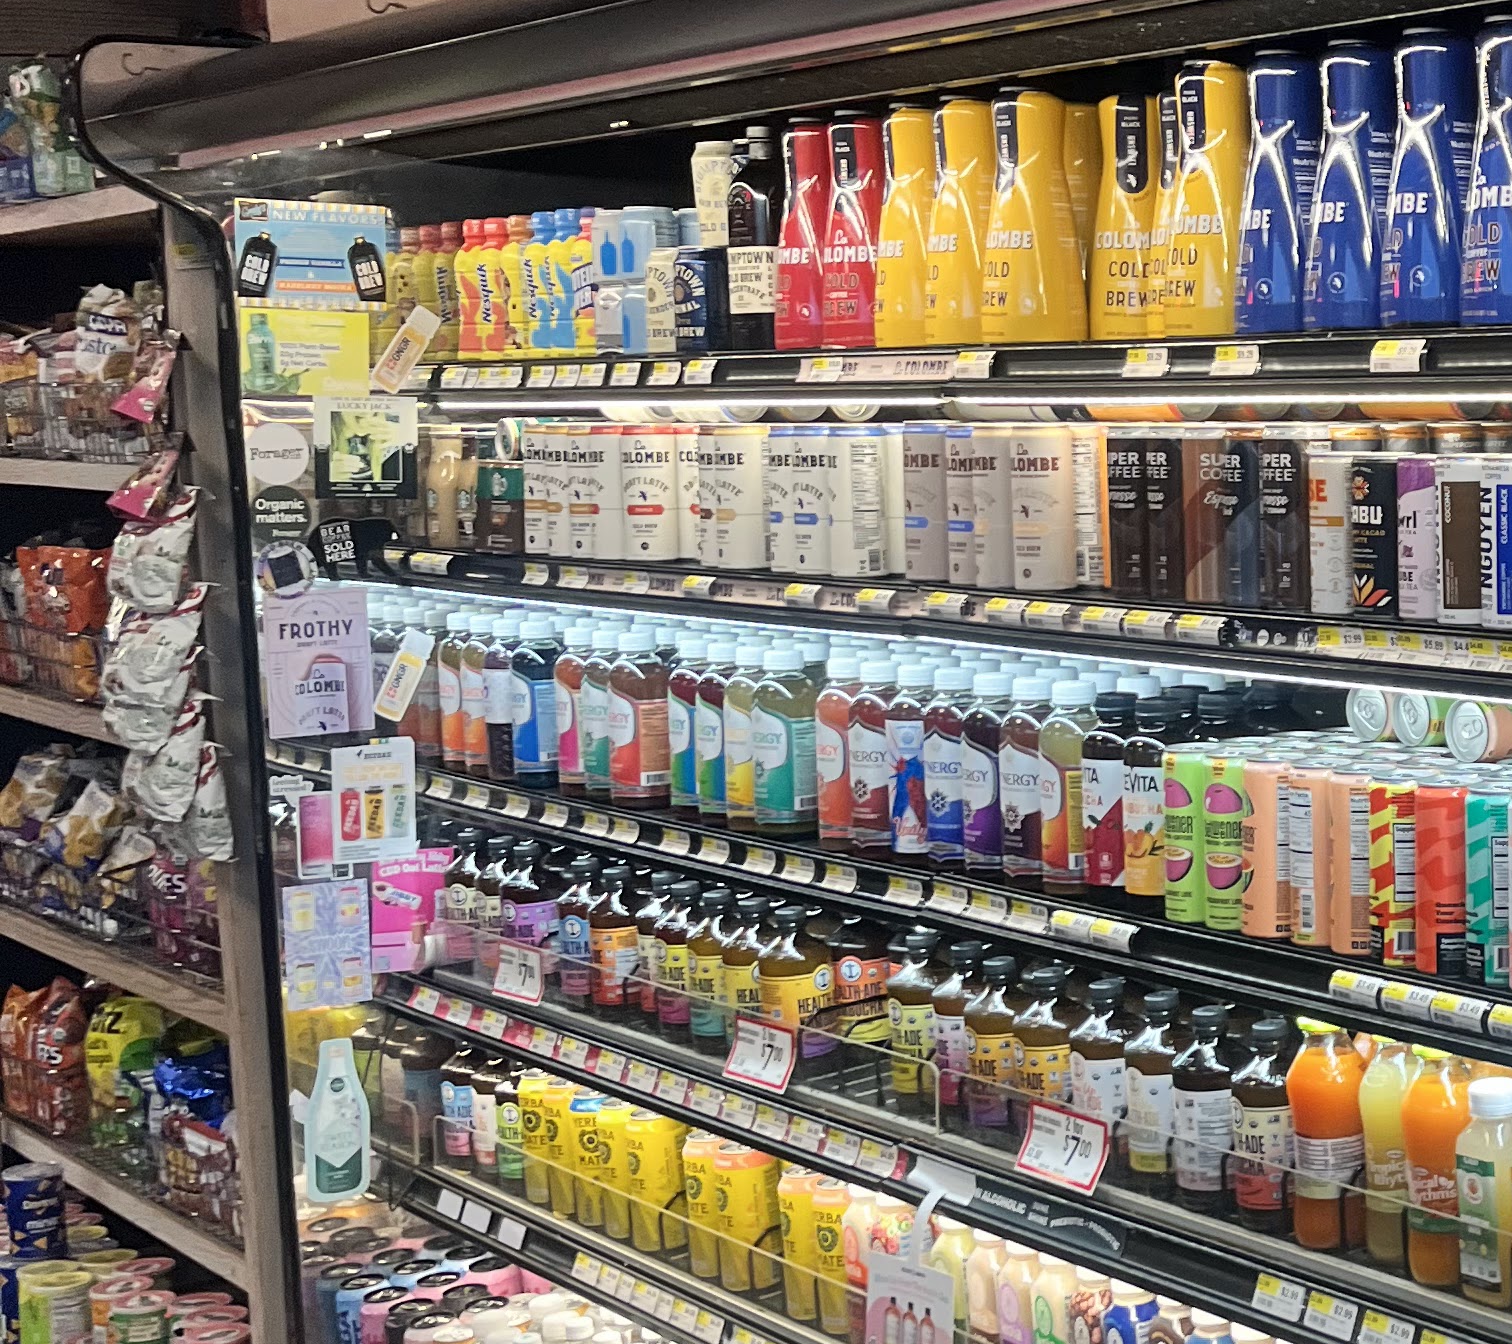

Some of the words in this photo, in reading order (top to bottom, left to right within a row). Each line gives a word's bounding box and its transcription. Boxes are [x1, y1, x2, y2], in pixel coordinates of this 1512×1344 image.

[255, 500, 304, 512] Organic
[255, 510, 307, 525] matters.
[325, 540, 355, 552] SOLD
[326, 549, 355, 562] HERE
[279, 619, 354, 640] FROTHY
